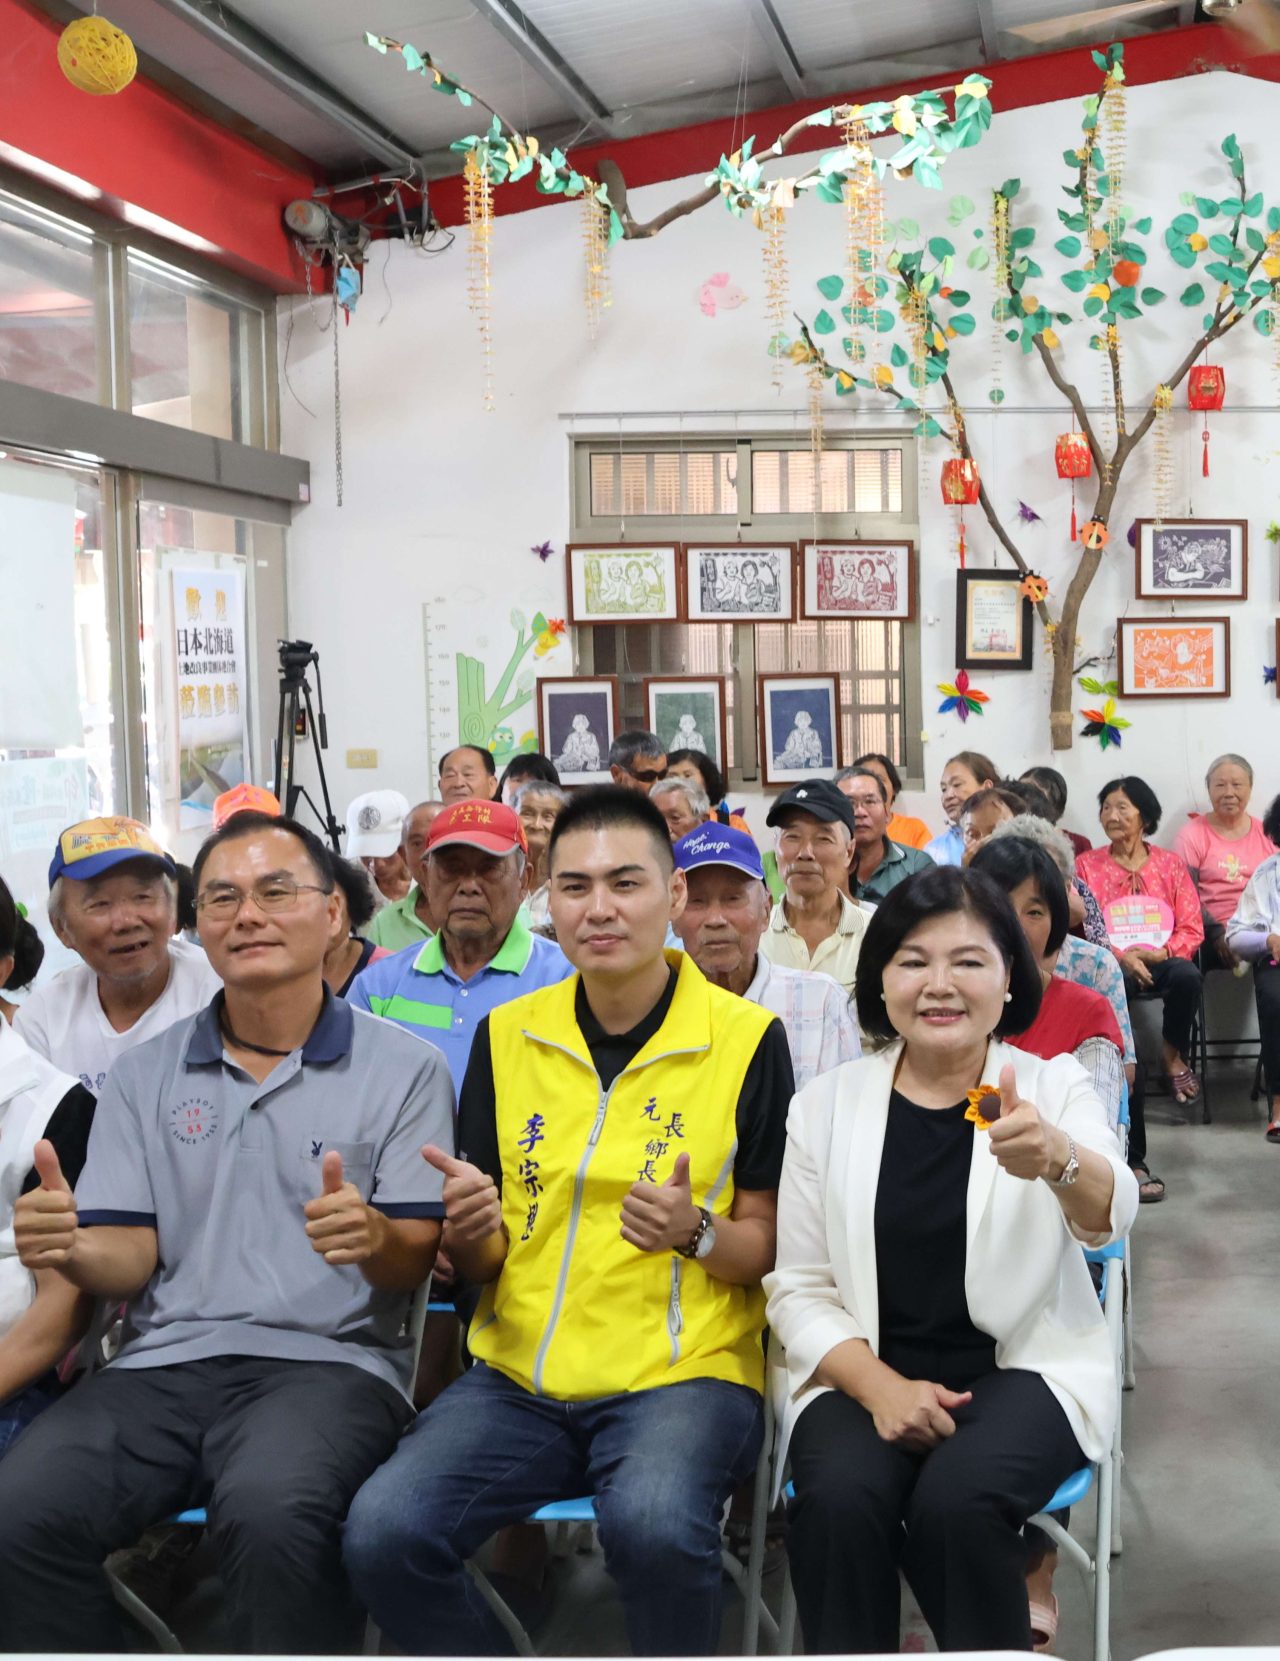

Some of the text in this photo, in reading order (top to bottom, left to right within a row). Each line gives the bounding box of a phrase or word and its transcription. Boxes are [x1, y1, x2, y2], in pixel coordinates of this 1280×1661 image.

[177, 627, 234, 656] 日本北海道
